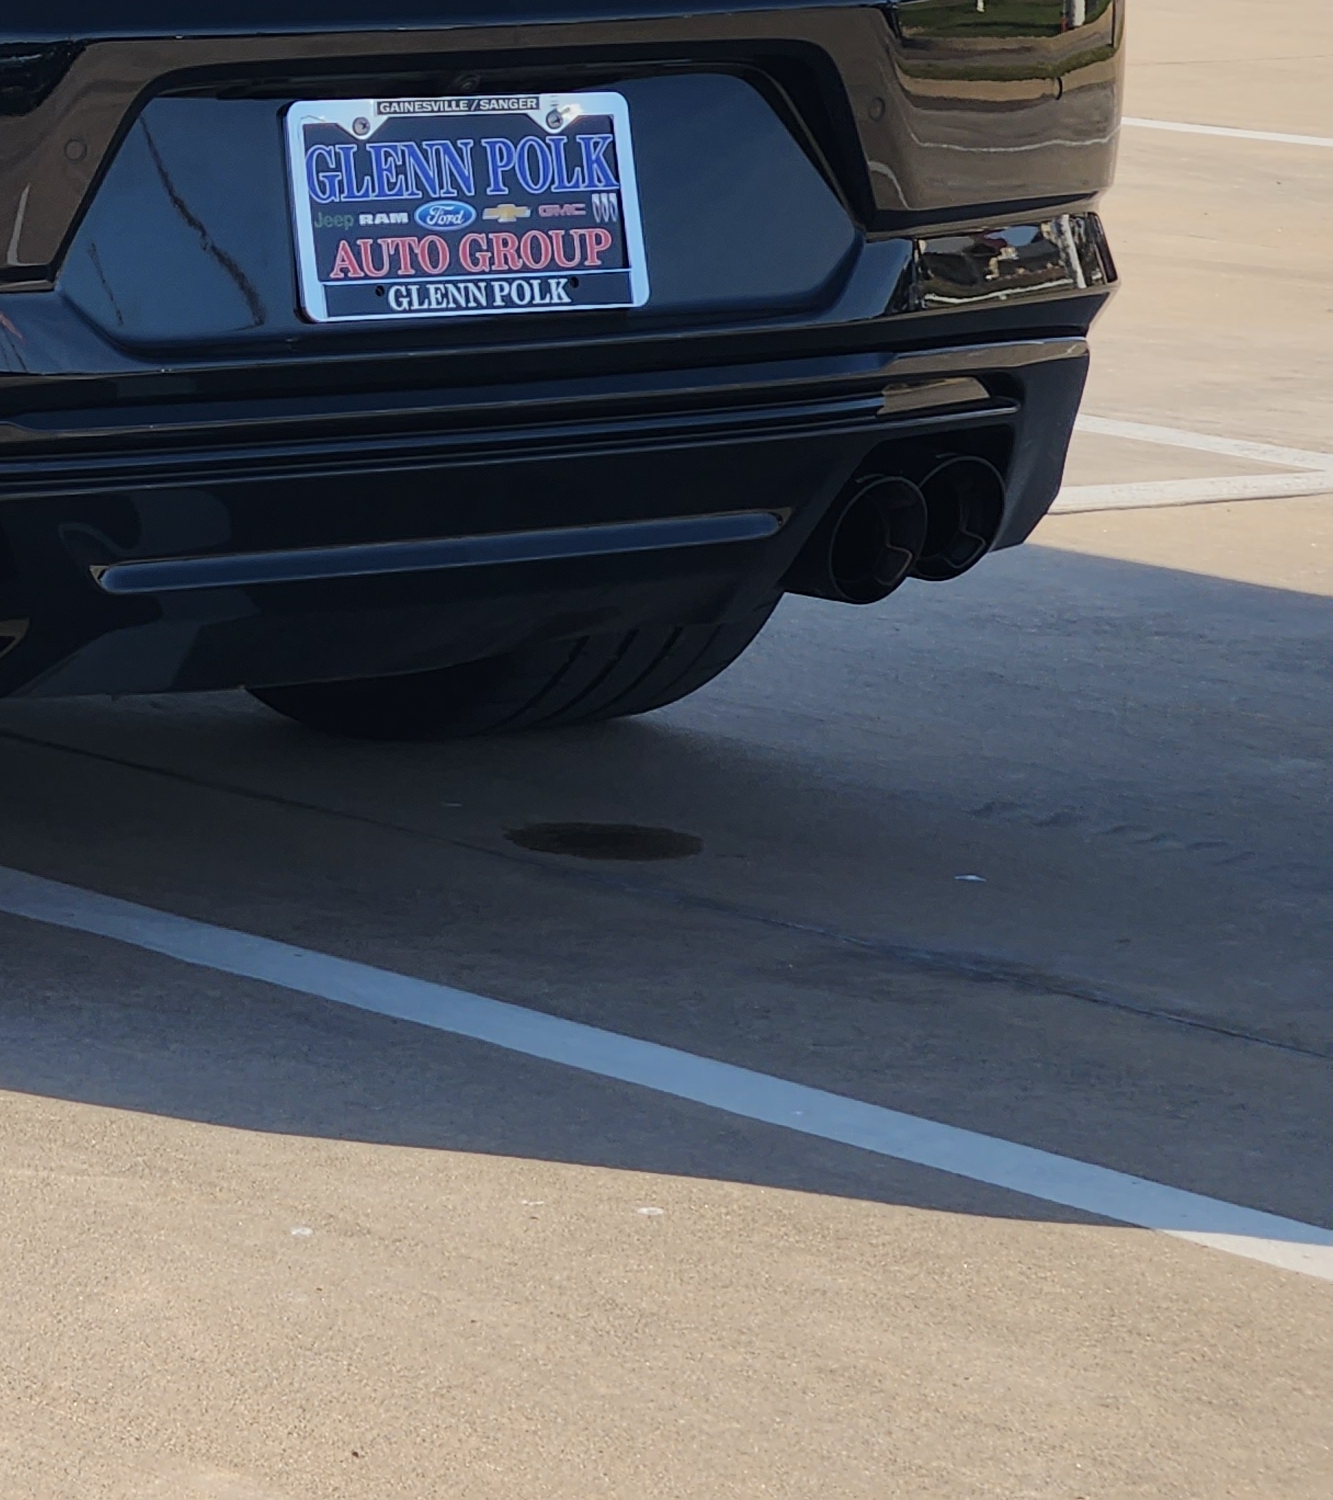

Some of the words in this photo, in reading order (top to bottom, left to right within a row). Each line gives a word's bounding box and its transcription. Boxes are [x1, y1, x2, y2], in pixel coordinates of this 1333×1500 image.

[305, 139, 474, 204] GLENN
[482, 133, 620, 195] POLK
[314, 211, 354, 231] Jeep
[359, 212, 409, 225] RAM
[426, 205, 464, 226] Ford
[538, 203, 586, 218] GMC
[329, 235, 450, 279] AUTO
[459, 228, 612, 273] GROUP
[388, 281, 487, 311] GLENN
[491, 278, 572, 306] POLK
